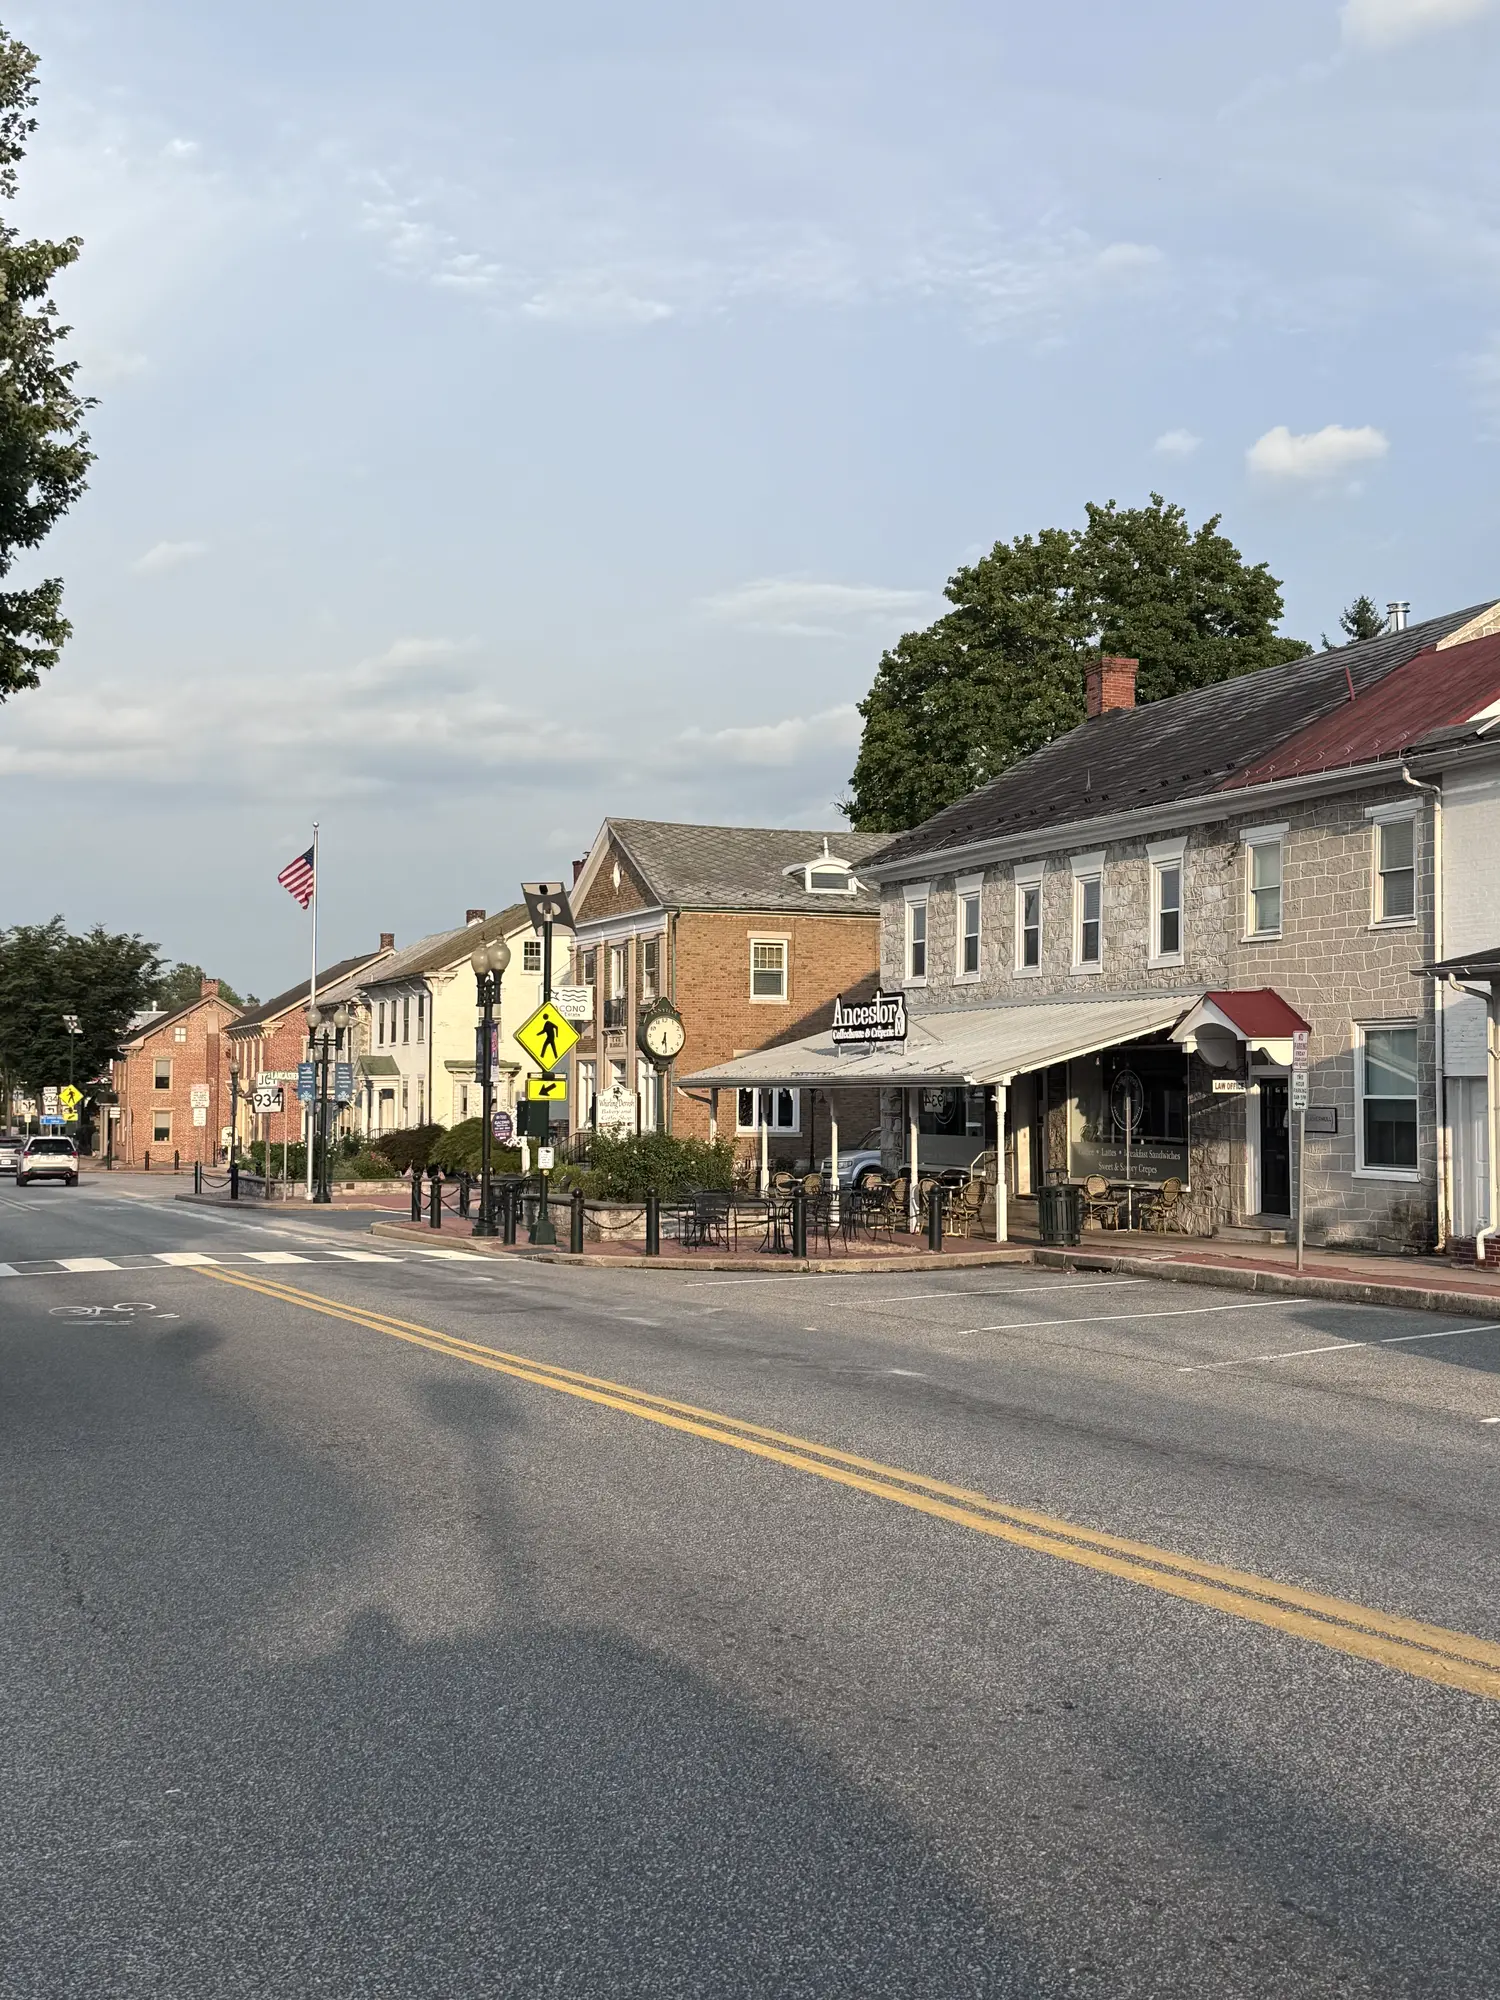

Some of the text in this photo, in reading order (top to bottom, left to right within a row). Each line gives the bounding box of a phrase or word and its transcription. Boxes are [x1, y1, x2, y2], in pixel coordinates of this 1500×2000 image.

[832, 991, 897, 1026] Ancestor
[865, 1028, 870, 1038] &
[1215, 1082, 1245, 1090] LAW OFFICE
[254, 1093, 281, 1107] 934
[1101, 1148, 1117, 1157] Lattes
[1149, 1150, 1181, 1160] Sandwiches
[1099, 1162, 1113, 1171] Sweet
[1114, 1162, 1119, 1171] &
[1138, 1164, 1157, 1176] Crepes
